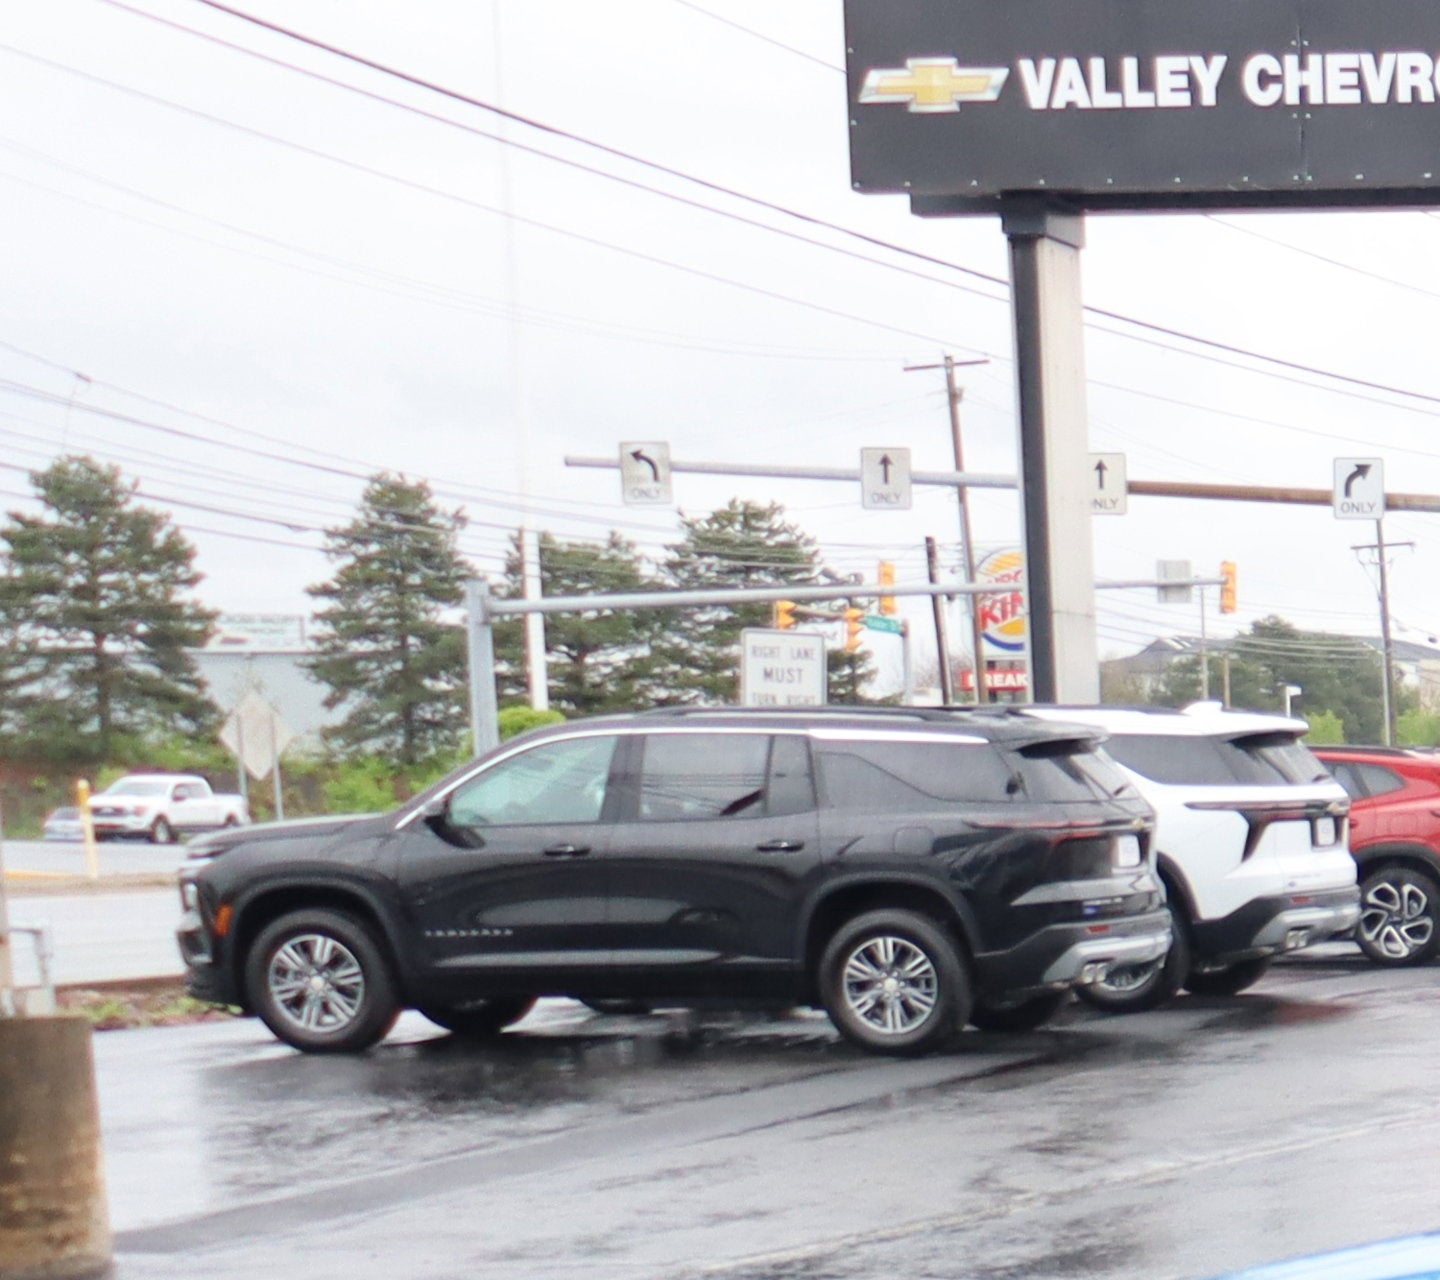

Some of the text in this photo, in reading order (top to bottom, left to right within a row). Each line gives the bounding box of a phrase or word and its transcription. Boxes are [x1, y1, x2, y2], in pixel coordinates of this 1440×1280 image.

[1018, 54, 1228, 110] VALLEY
[631, 486, 660, 500] ONLY
[871, 492, 902, 504] ONLY
[1091, 497, 1119, 510] NLY
[1340, 501, 1377, 514] ONLY
[763, 667, 804, 683] MUST
